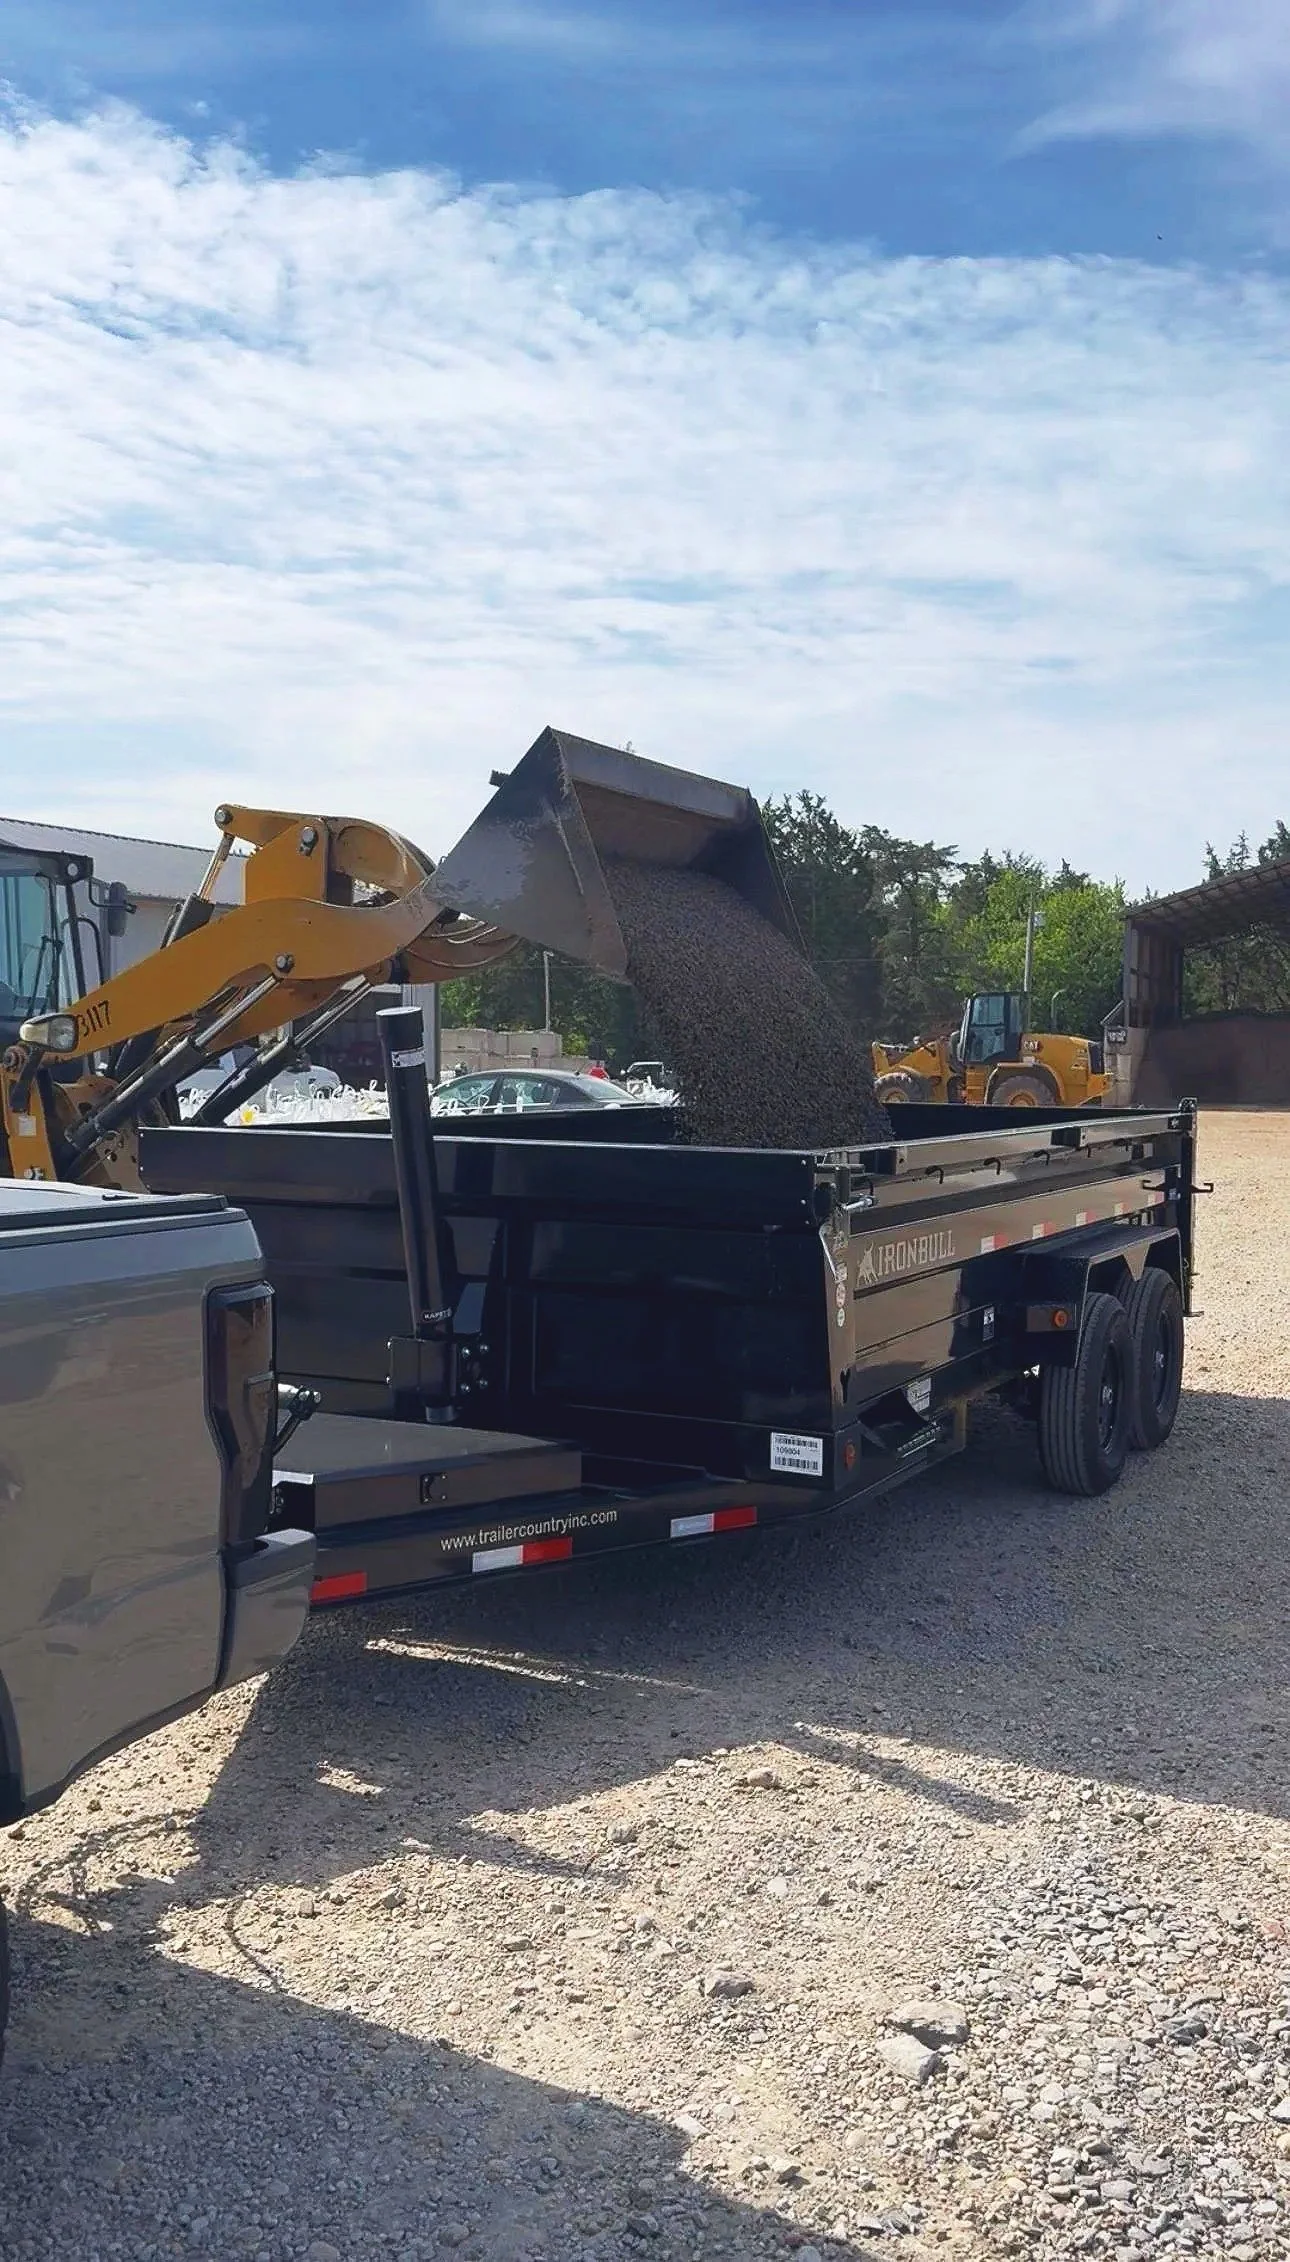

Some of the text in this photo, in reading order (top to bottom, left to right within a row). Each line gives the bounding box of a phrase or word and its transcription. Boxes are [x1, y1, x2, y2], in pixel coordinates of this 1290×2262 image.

[77, 1000, 111, 1037] 3117
[1023, 1040, 1040, 1051] CAT
[877, 1229, 956, 1277] IRONBULL
[440, 1509, 618, 1551] www.trailercountryinc.com
